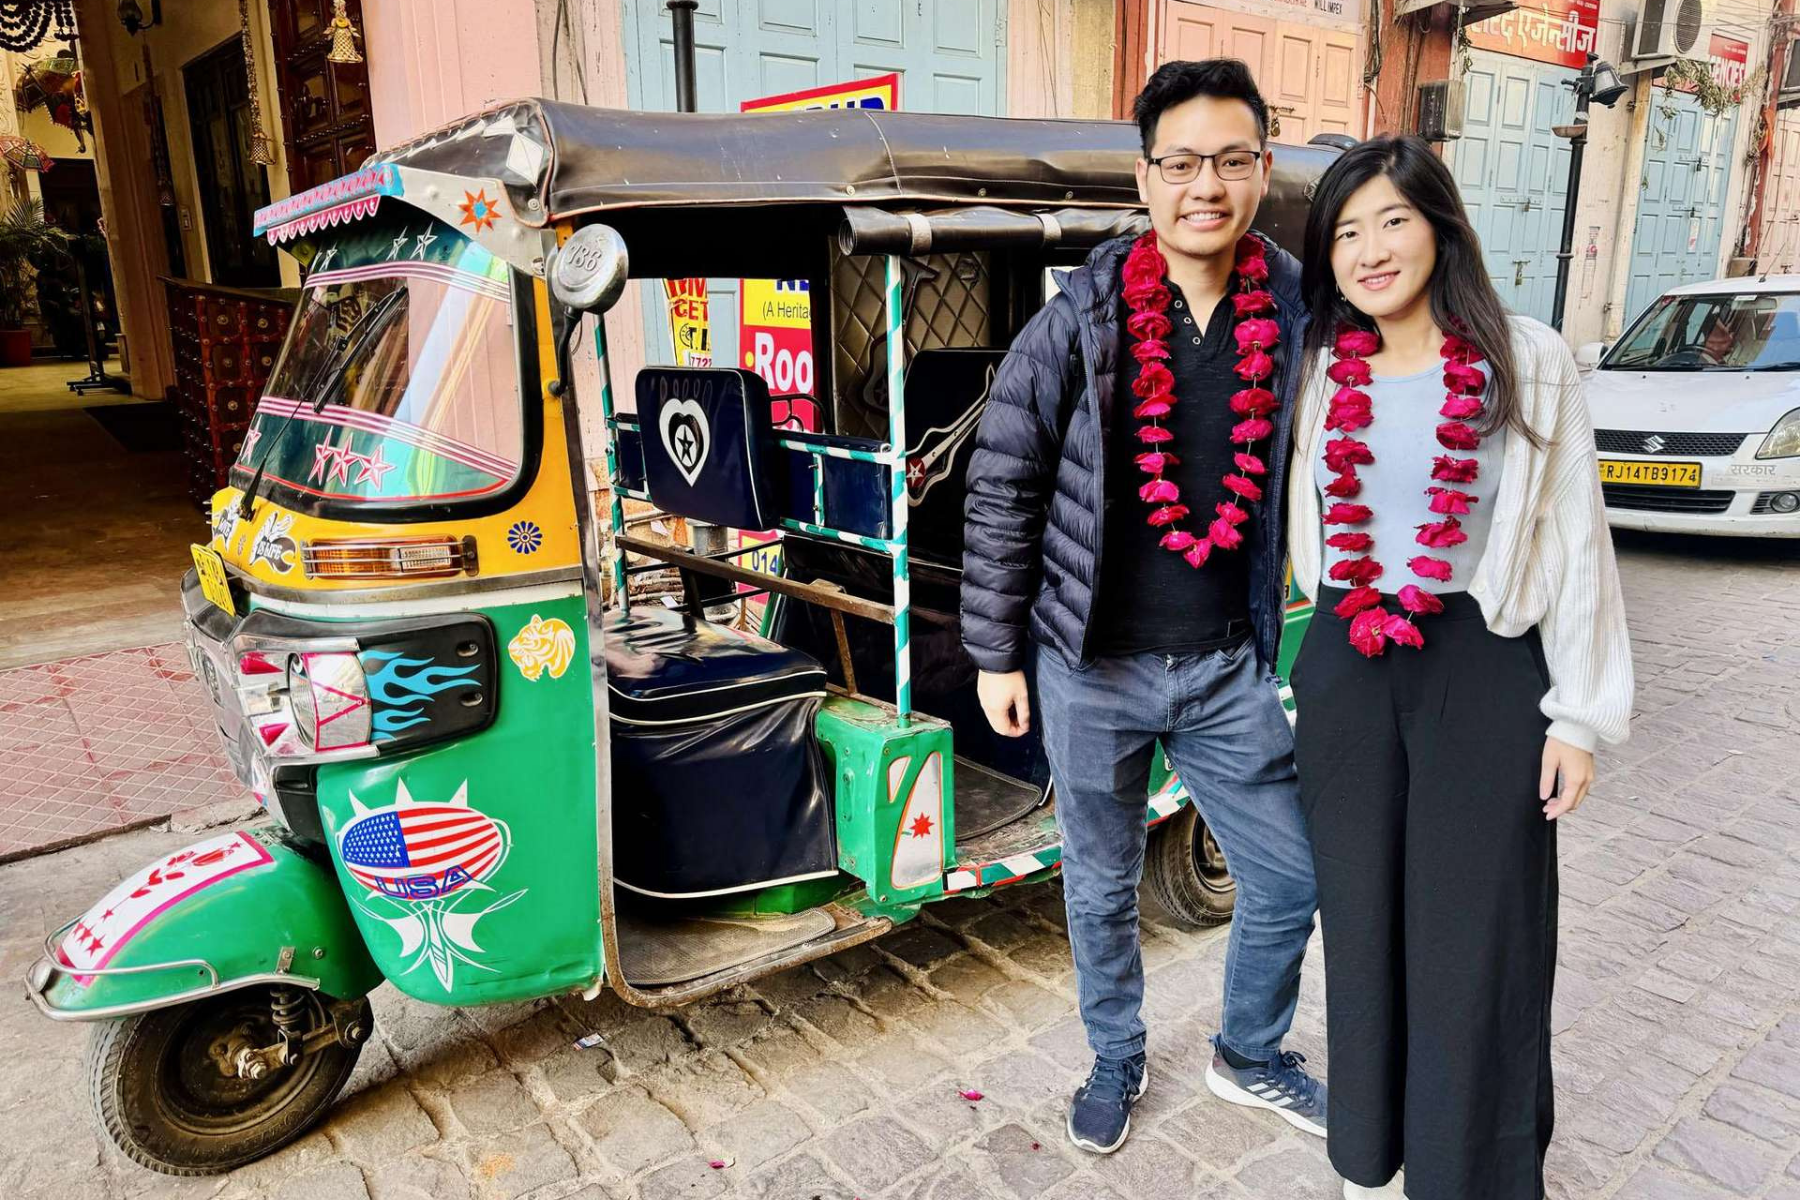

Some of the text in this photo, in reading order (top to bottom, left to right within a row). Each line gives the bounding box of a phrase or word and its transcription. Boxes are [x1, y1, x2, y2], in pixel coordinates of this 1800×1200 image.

[777, 301, 811, 320] Herita
[1606, 464, 1697, 483] RJ14TB9174
[1731, 464, 1777, 476] सरकार
[375, 865, 473, 900] USA
